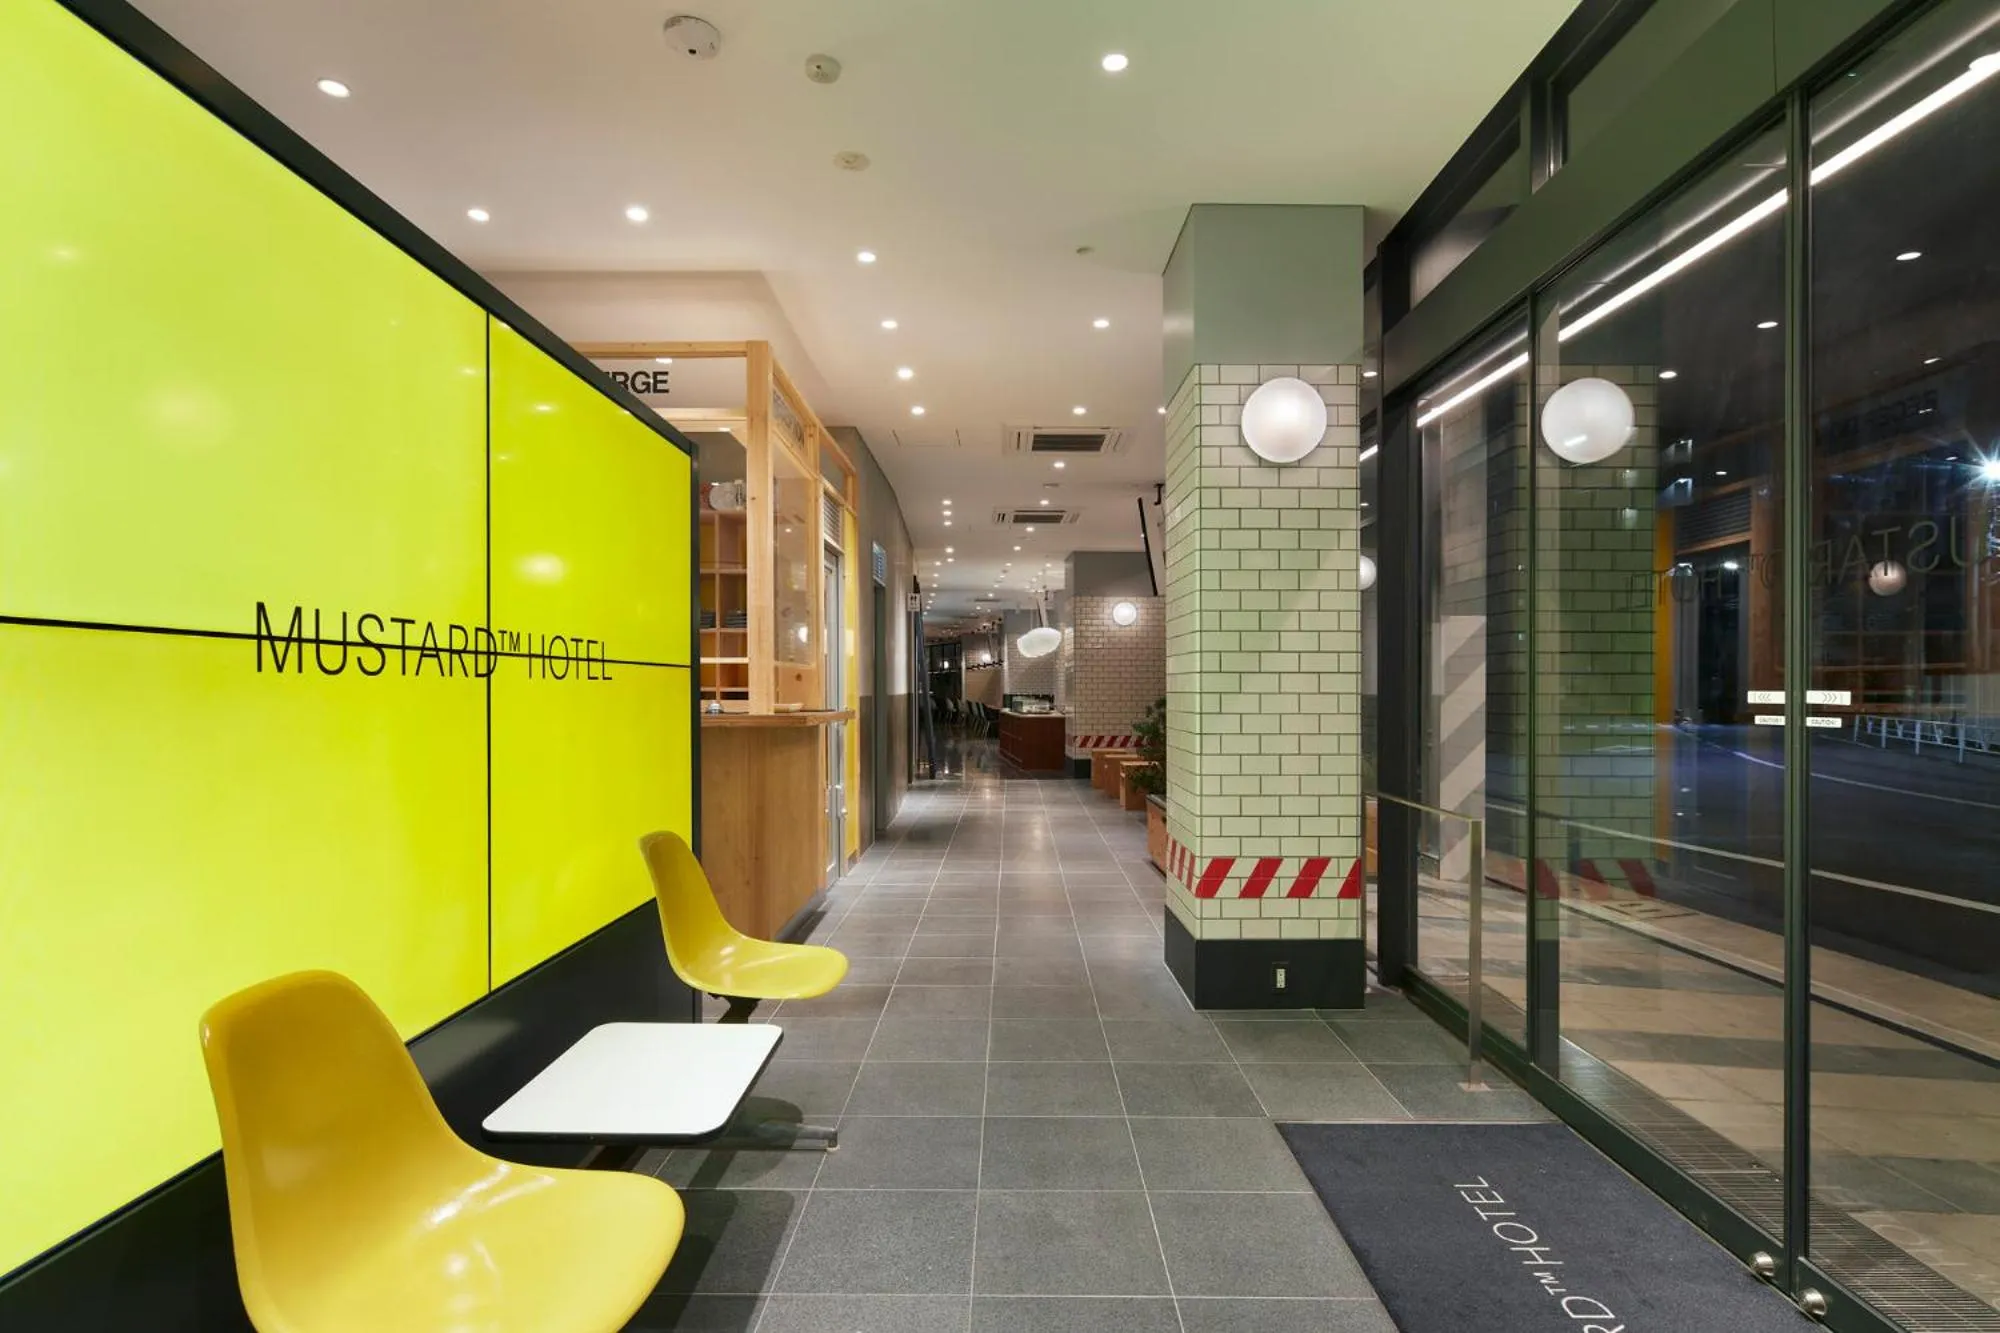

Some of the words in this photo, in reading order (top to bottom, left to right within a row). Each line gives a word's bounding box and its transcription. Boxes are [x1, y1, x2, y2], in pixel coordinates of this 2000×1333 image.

[603, 370, 669, 394] RGE
[528, 632, 613, 681] HOTEL
[1453, 1175, 1564, 1265] HOTEL
